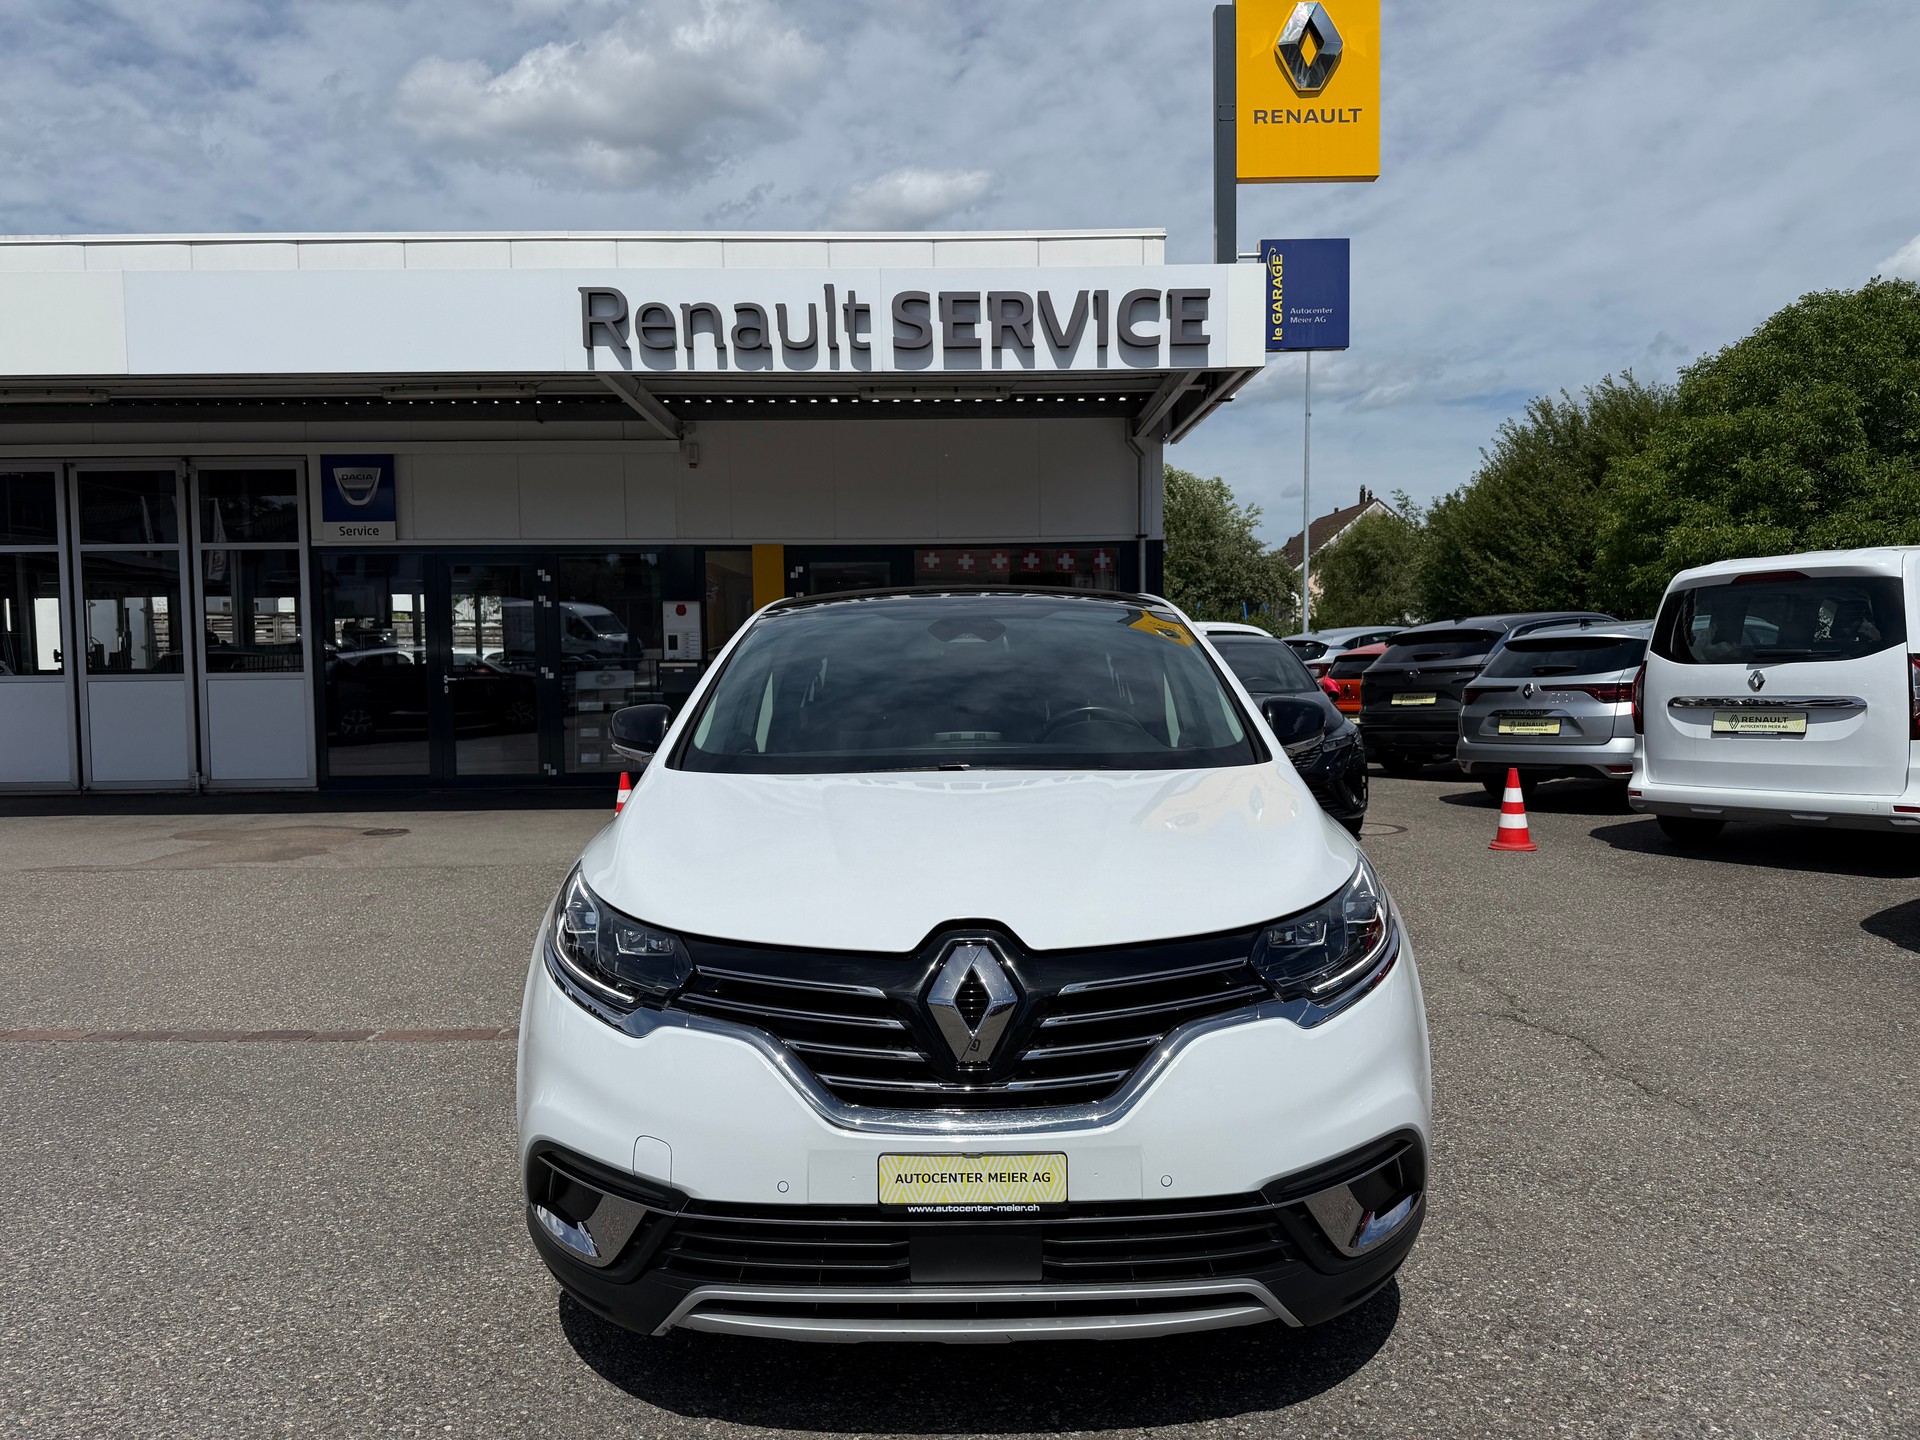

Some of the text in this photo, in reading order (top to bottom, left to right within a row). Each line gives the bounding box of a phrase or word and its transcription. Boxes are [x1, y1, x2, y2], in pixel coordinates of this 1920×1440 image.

[1253, 108, 1363, 124] RENAULT
[1271, 253, 1283, 341] le GARAGE
[577, 283, 1211, 351] Renault SERVICE
[1289, 307, 1333, 315] Autocenter
[1289, 315, 1327, 324] Meier AG
[341, 473, 374, 481] DACIA
[338, 525, 380, 537] Service
[895, 1171, 1051, 1184] AUTOCENTER MEIER AG
[907, 1203, 1040, 1213] www.autocenter-meier.ch
